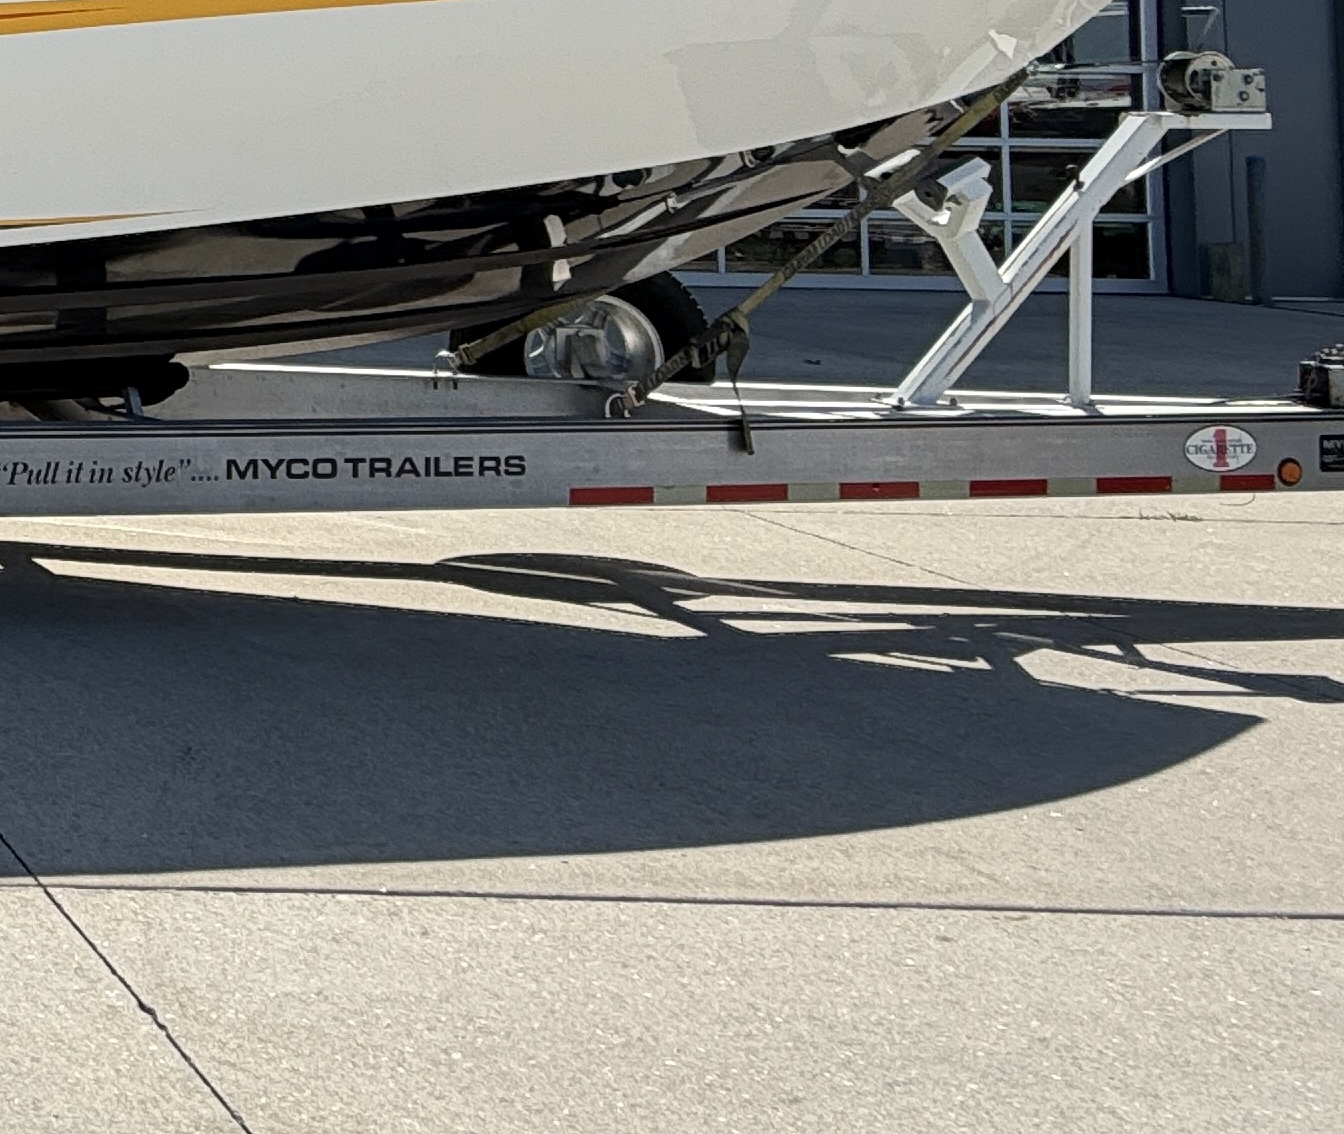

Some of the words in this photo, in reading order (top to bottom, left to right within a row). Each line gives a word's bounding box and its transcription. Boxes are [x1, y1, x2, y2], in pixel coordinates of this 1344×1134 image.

[65, 460, 84, 484] it
[89, 460, 114, 484] in
[225, 457, 339, 481] MYCO
[343, 454, 527, 479] TRAILERS
